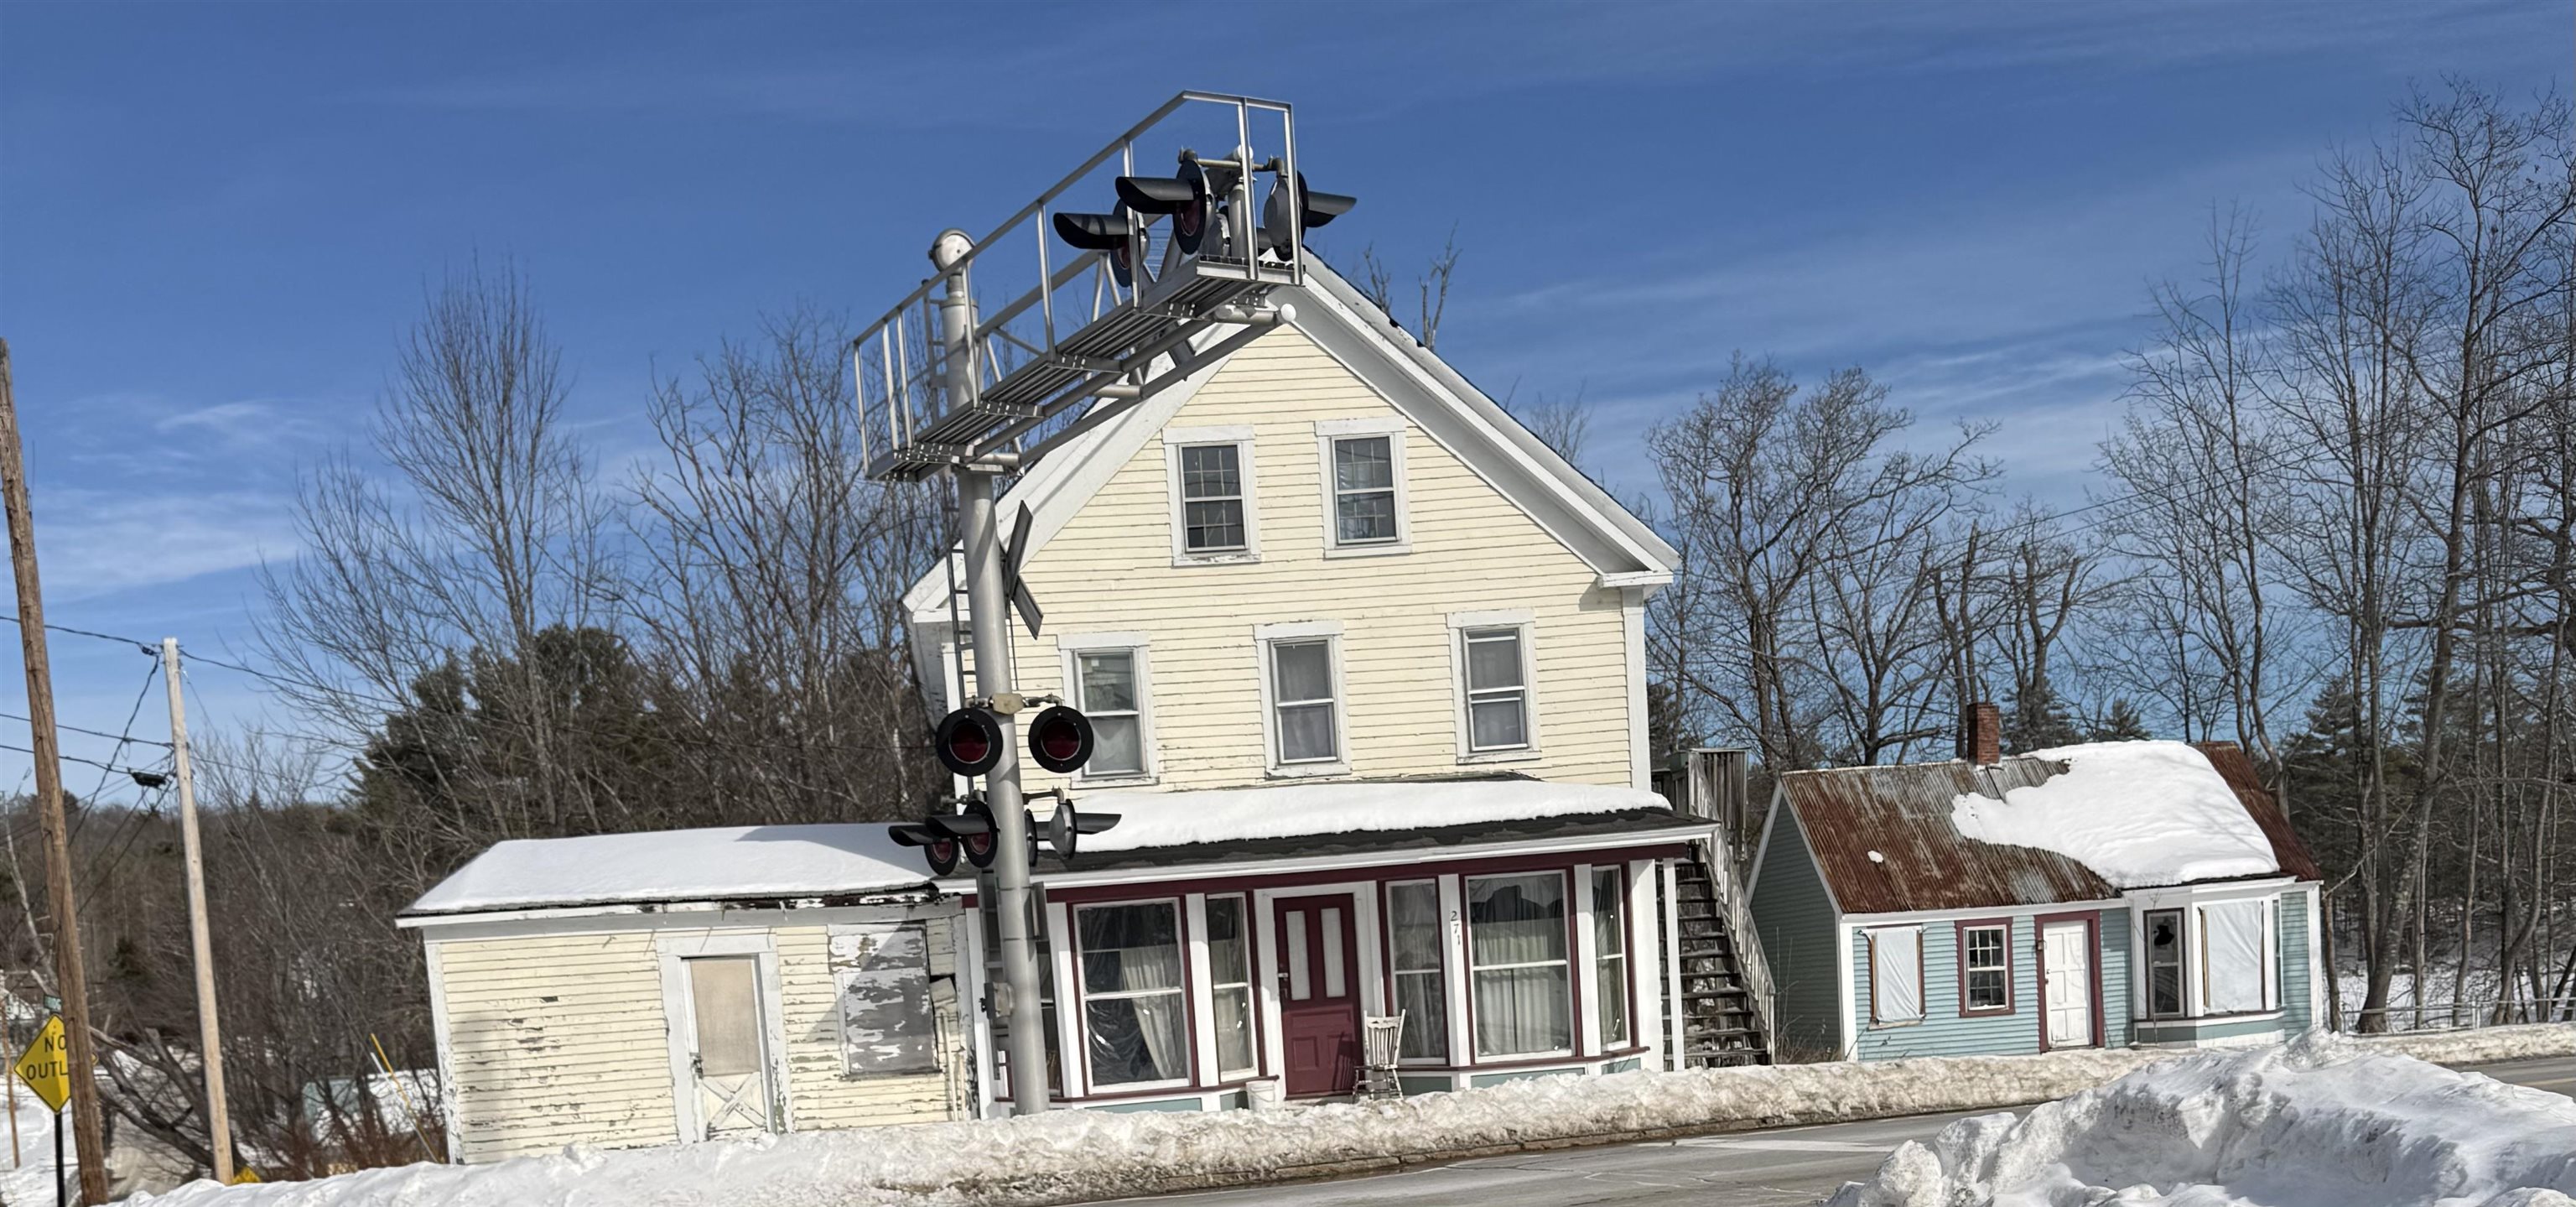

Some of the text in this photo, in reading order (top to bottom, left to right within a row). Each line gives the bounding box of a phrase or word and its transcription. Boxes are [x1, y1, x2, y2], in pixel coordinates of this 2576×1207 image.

[1451, 910, 1461, 945] 271
[44, 1034, 66, 1053] NO
[26, 1060, 69, 1080] OUTL
